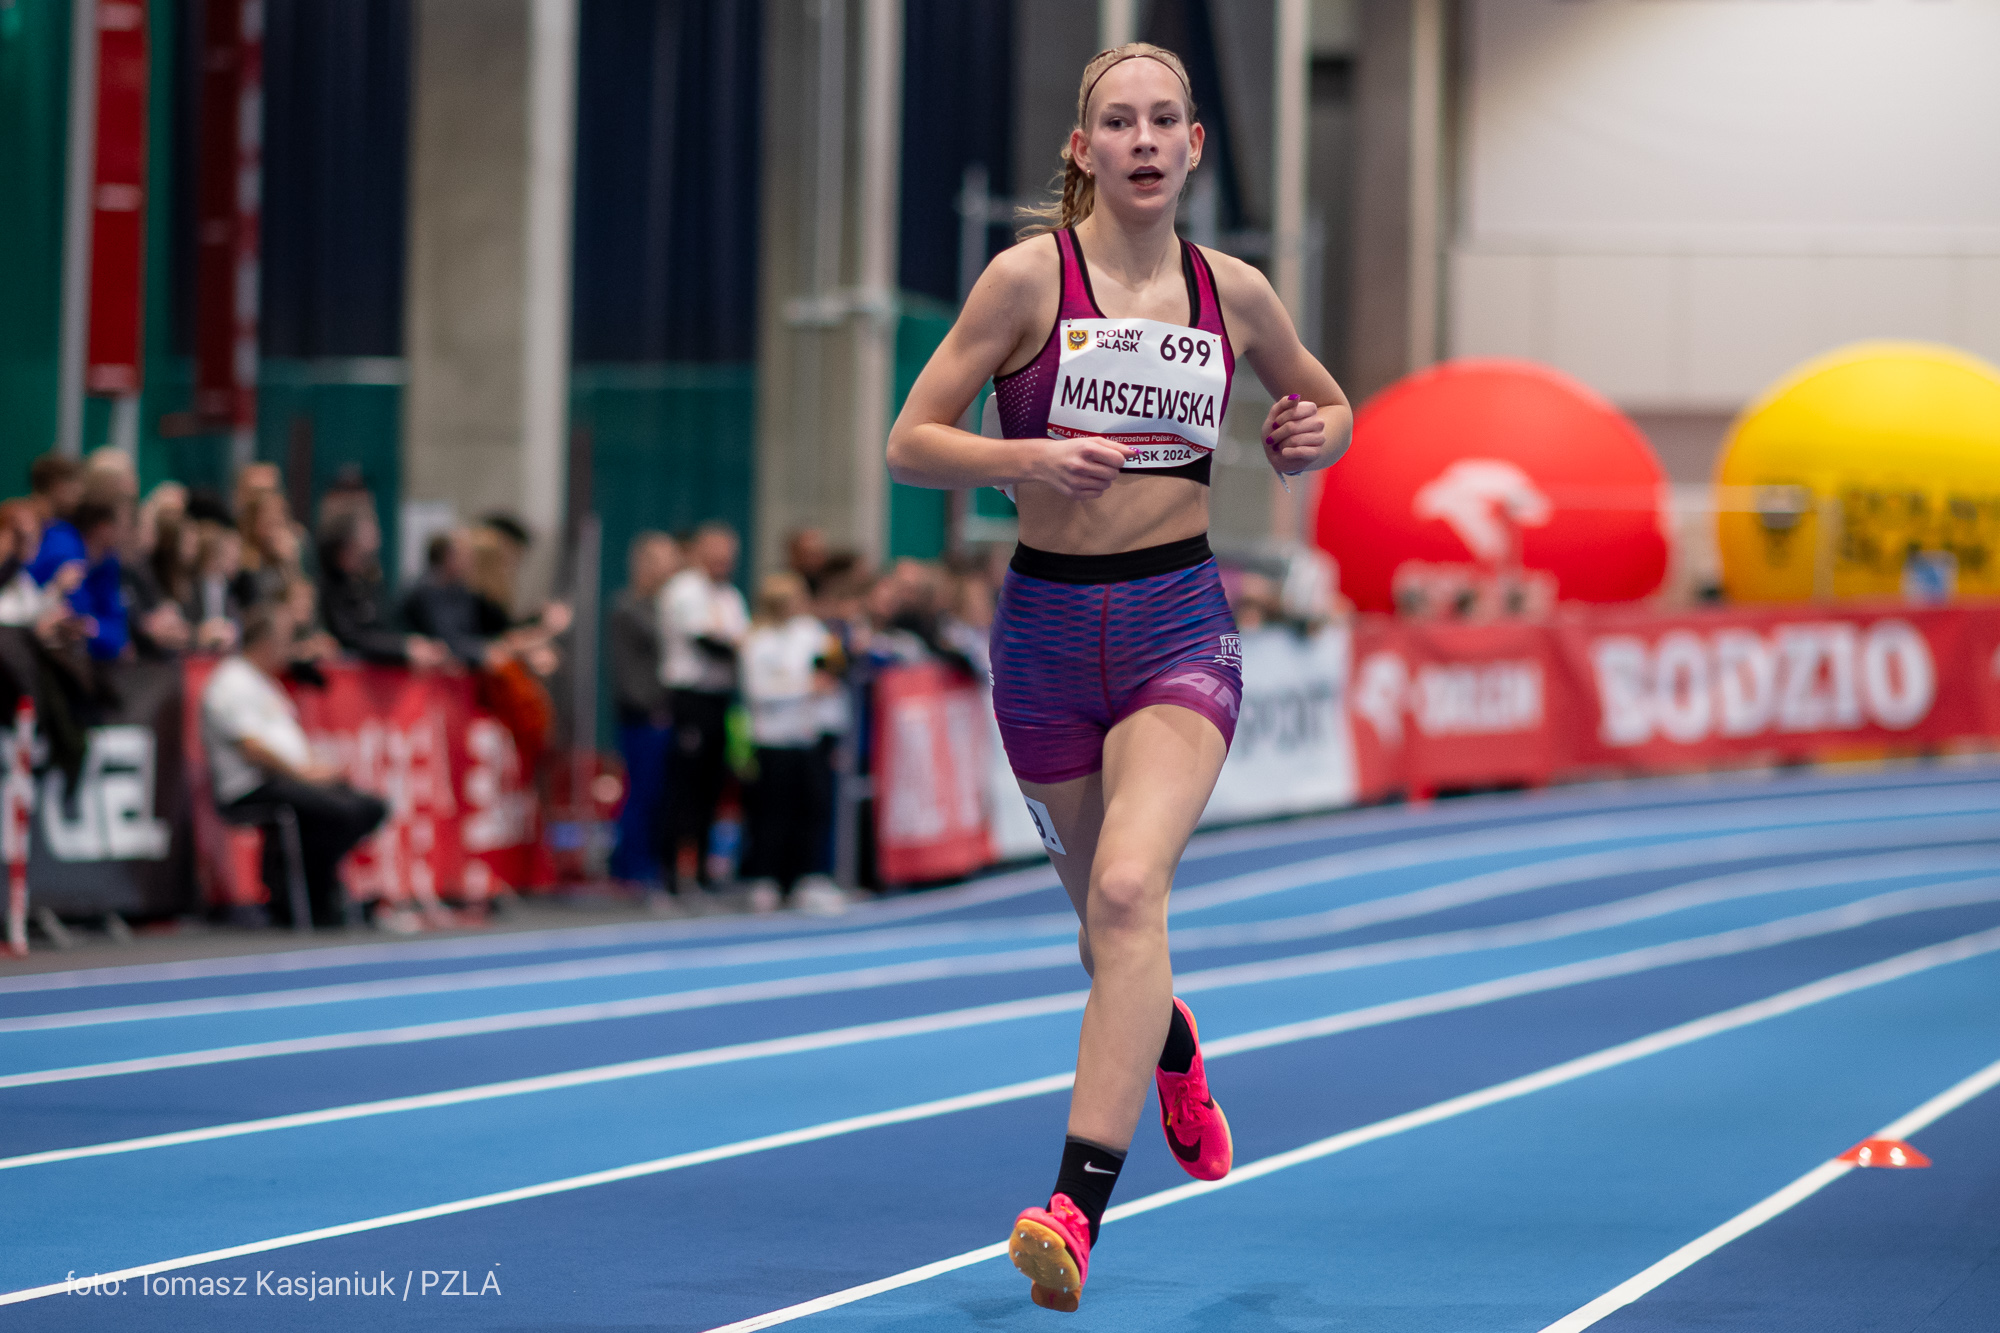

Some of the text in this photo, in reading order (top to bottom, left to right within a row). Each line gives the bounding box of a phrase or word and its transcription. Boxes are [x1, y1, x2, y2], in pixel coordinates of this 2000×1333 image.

[1096, 329, 1143, 340] DOLNY
[1160, 334, 1211, 366] 699
[1060, 375, 1215, 428] MARSZEWSKA
[1106, 435, 1150, 443] Mistrzostwa
[1124, 449, 1191, 465] LĄSK 2024
[1595, 622, 1934, 746] BODZIO
